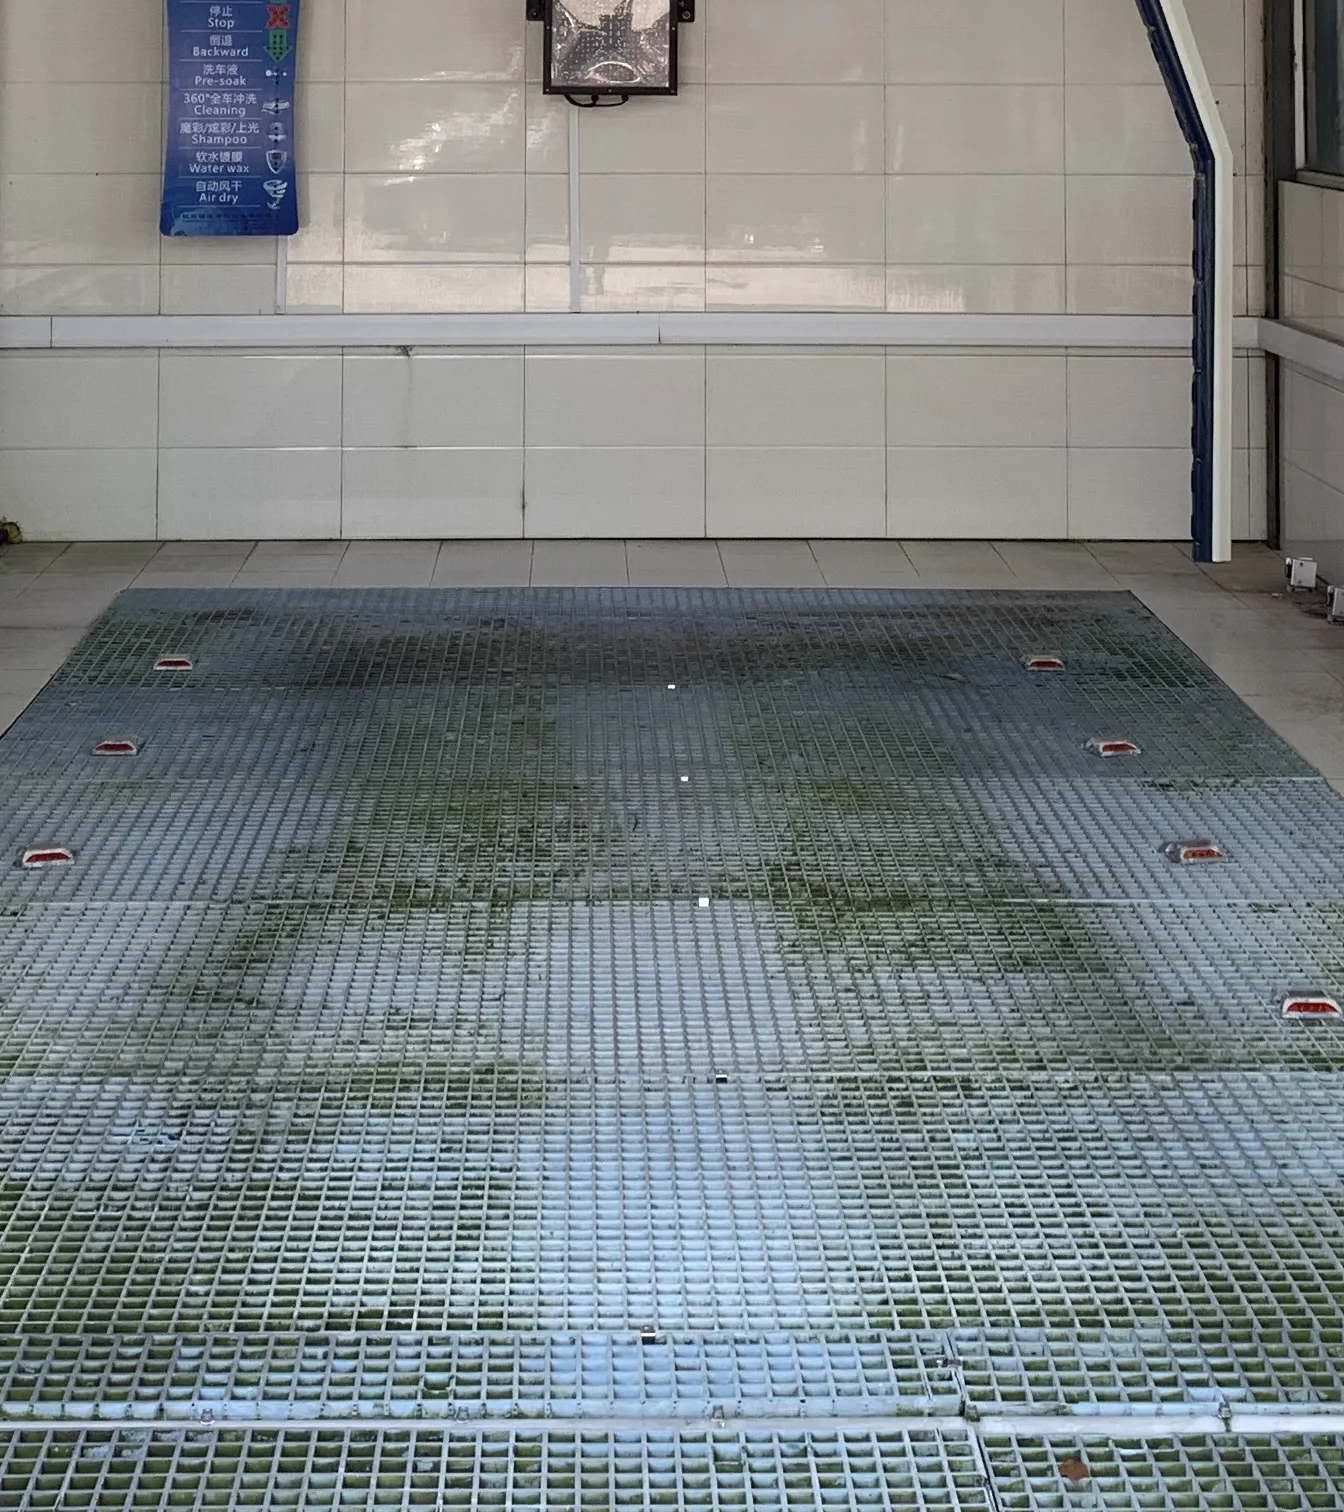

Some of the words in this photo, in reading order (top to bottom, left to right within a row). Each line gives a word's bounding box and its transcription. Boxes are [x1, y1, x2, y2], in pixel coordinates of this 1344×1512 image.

[209, 5, 233, 17] 停止
[208, 17, 235, 29] Stop
[193, 46, 249, 57] Backward
[203, 64, 238, 75] 洗车液
[195, 76, 246, 86] Pre-soak
[183, 93, 257, 105] 360°全车冲洗
[194, 106, 246, 117] Cleaning
[192, 134, 247, 146] Shampoo
[189, 163, 224, 173] Water
[227, 165, 250, 173] wax
[196, 180, 243, 192] 自动风干
[199, 193, 216, 202] Air
[219, 193, 239, 204] dry
